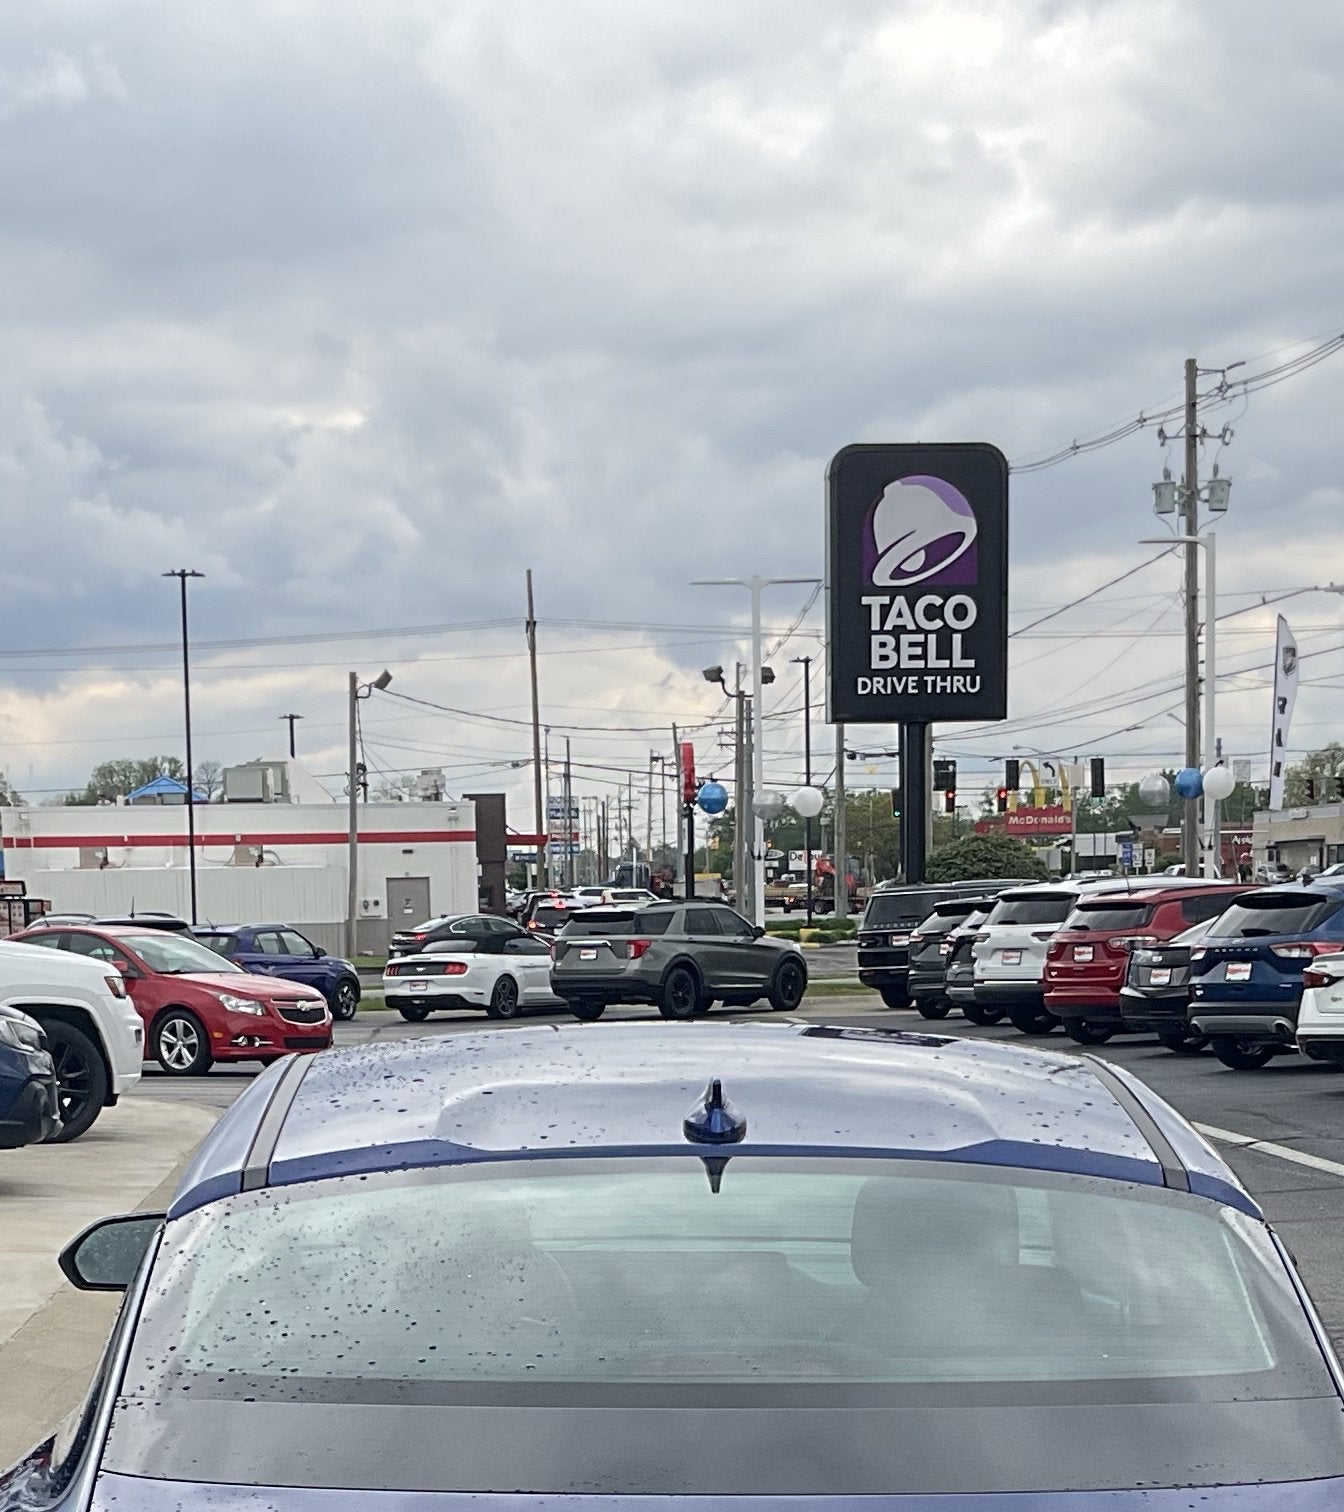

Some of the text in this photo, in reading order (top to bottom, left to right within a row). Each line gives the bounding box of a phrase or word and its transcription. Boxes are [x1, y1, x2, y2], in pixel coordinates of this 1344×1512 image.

[861, 594, 978, 631] TACO
[871, 633, 975, 669] BELL
[857, 675, 981, 695] DRIVE THRU
[1008, 815, 1072, 825] McDonald's
